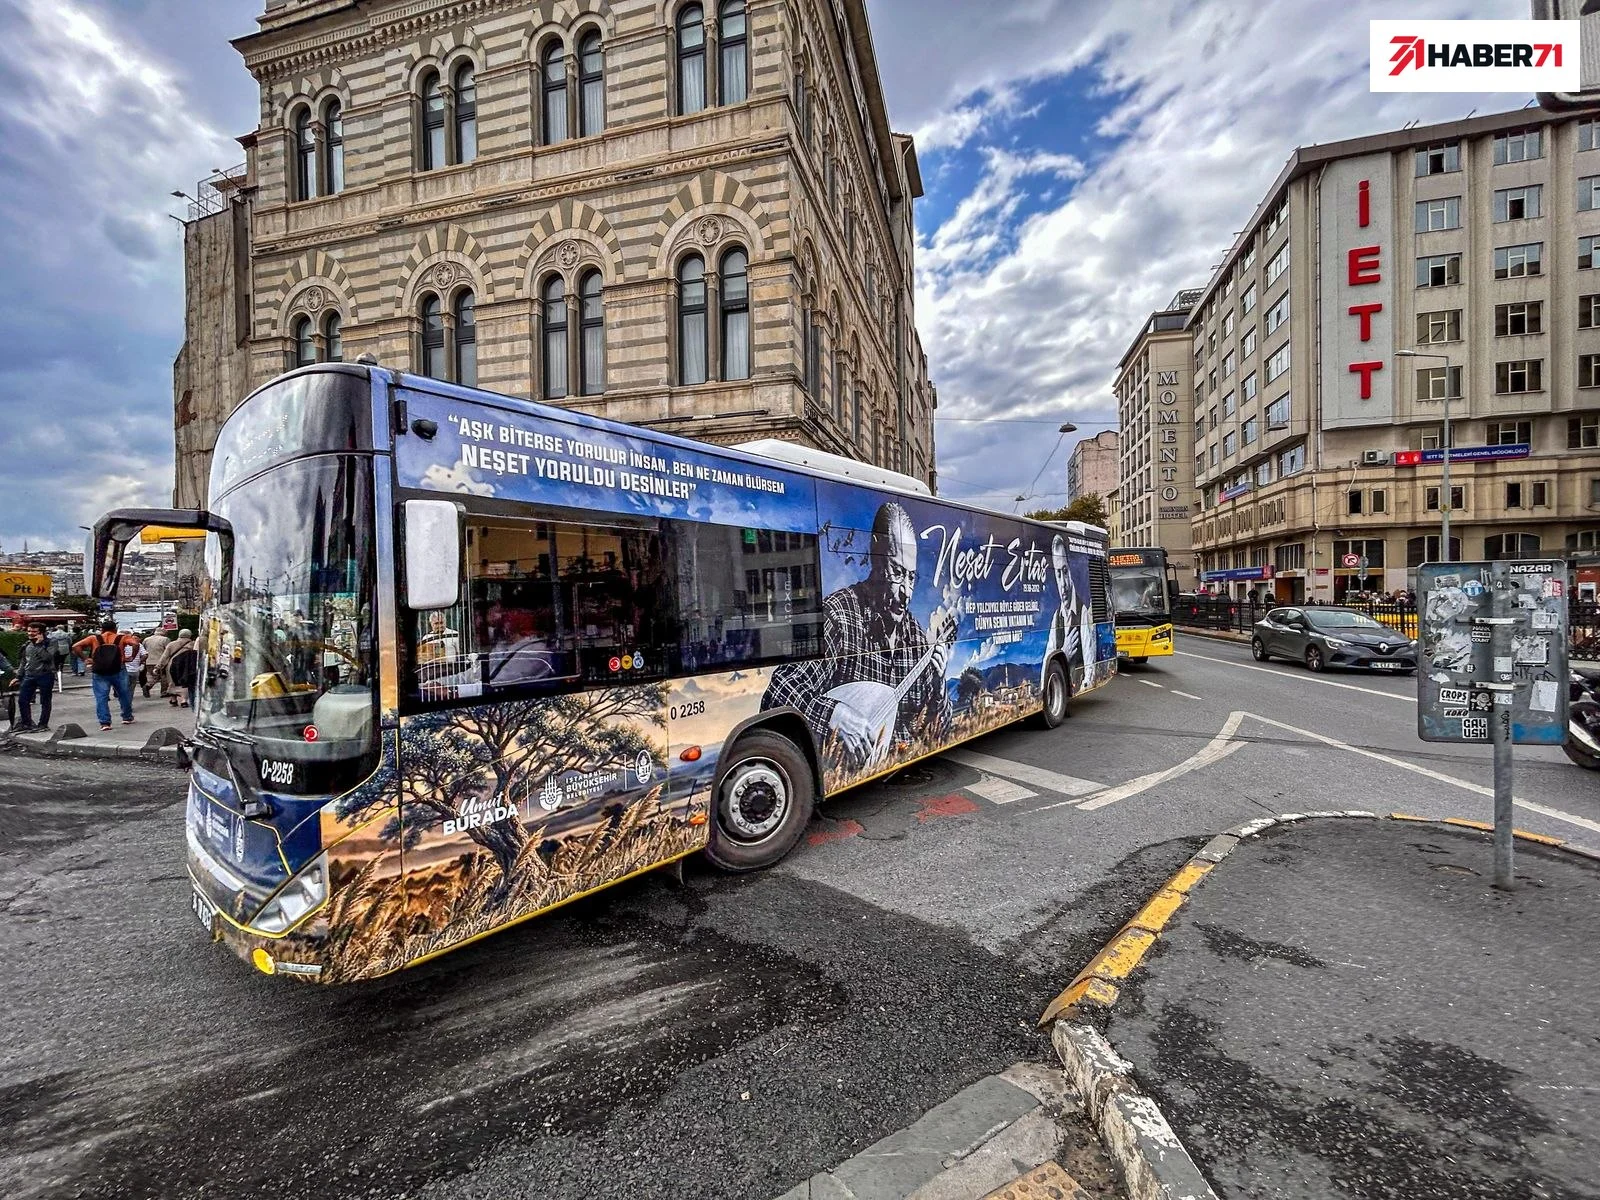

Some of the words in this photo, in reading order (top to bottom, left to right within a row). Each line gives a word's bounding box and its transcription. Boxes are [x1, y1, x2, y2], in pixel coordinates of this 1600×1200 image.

[1348, 179, 1384, 400] İETT
[1157, 370, 1179, 501] MOMENTO
[461, 444, 530, 476] NEŞET
[534, 456, 616, 488] YORULDU
[499, 424, 564, 454] BİTERSE
[566, 439, 627, 465] YORULUR
[630, 449, 671, 475] İNSAN,
[673, 461, 694, 478] BEN
[696, 466, 710, 481] NE
[711, 469, 744, 487] ZAMAN
[745, 473, 785, 495] ÖLÜRSEM
[920, 524, 1005, 592] Neşet
[1001, 537, 1049, 592] Ertaş
[1510, 564, 1553, 574] NAZAR
[13, 583, 33, 594] Ptt
[680, 700, 705, 718] 2258
[1441, 689, 1468, 701] CROPS
[1463, 728, 1487, 738] USH
[459, 792, 504, 817] Umut
[443, 803, 519, 836] BURADA
